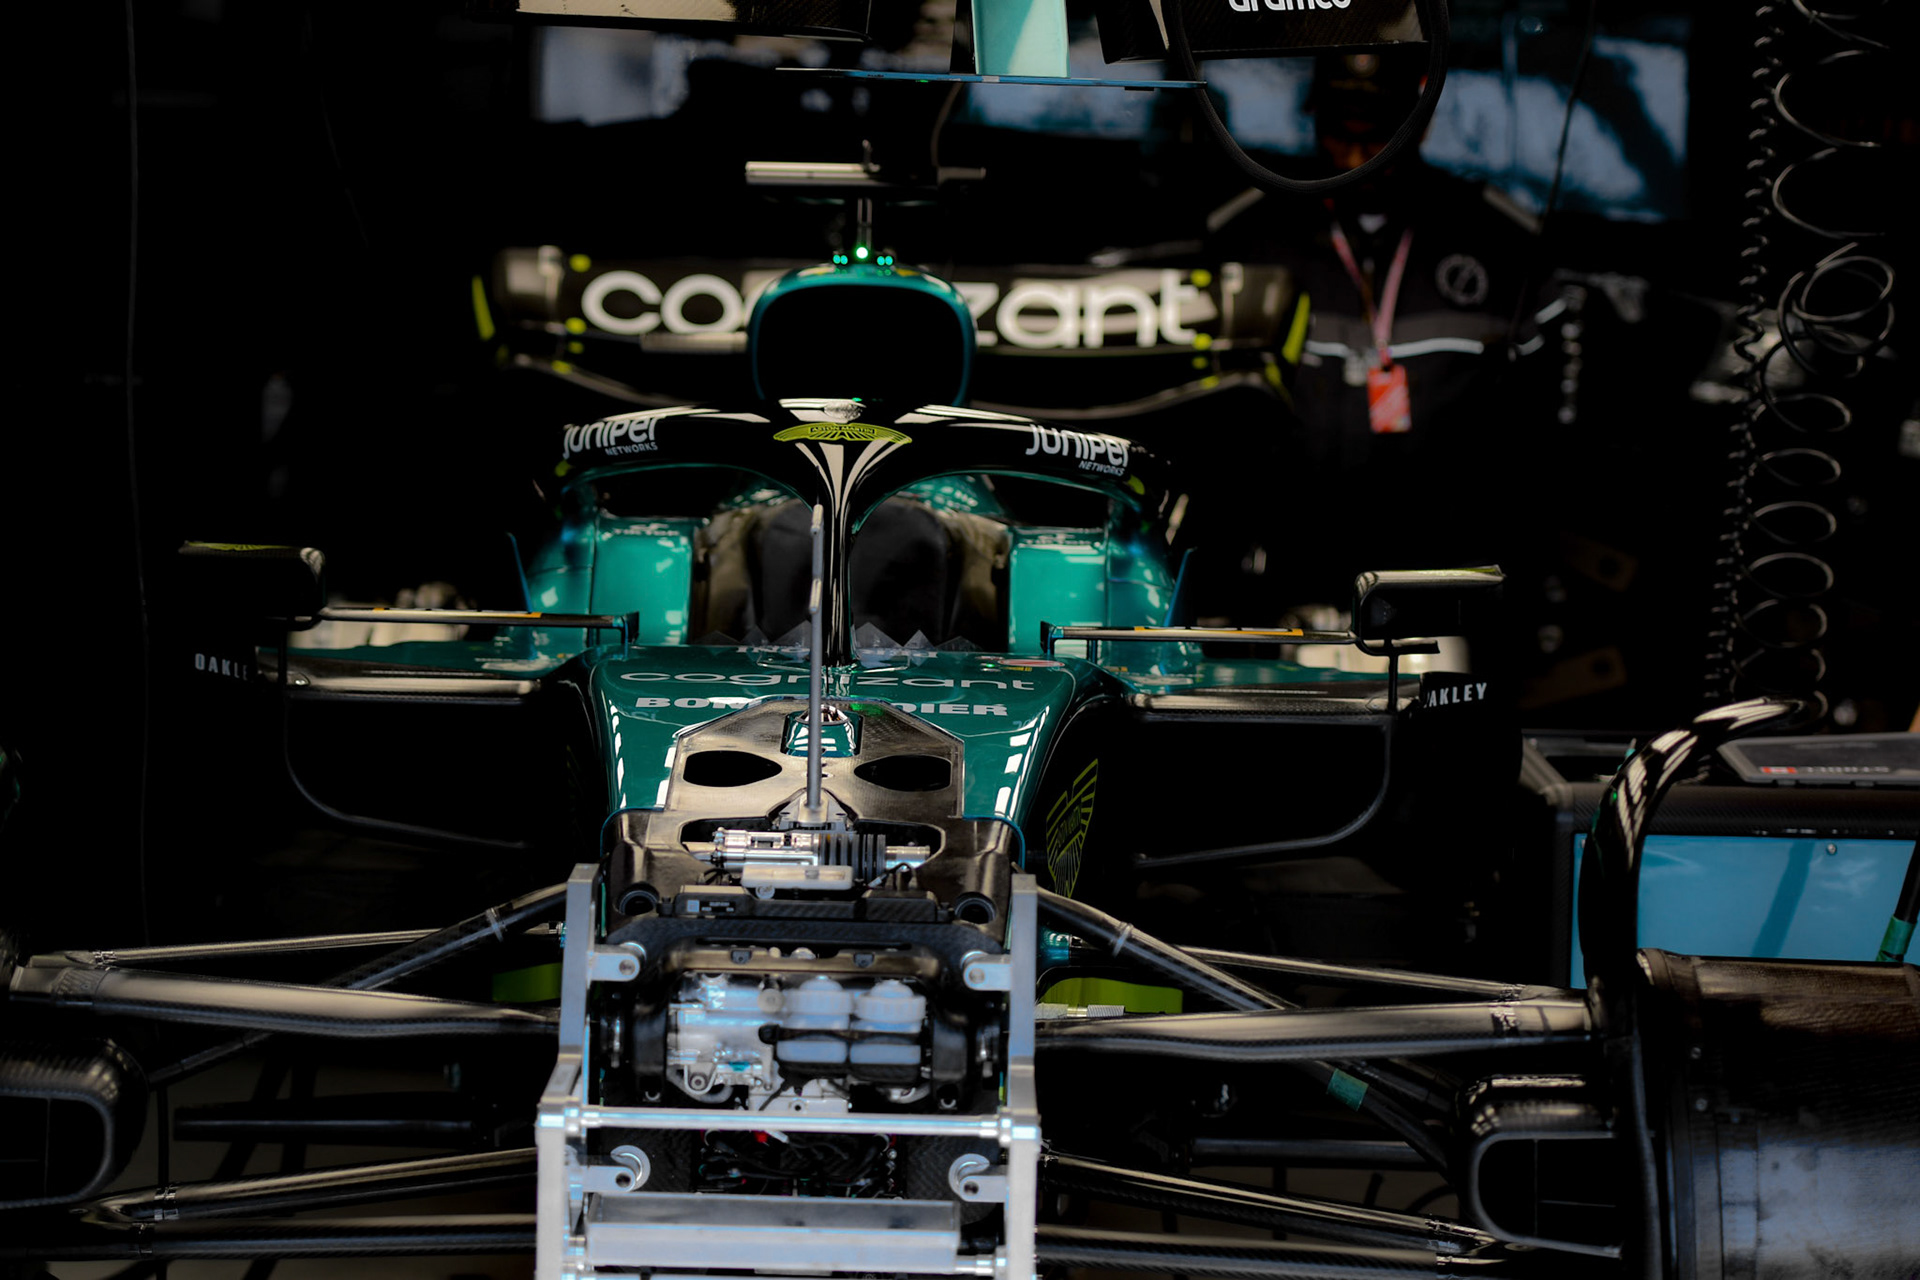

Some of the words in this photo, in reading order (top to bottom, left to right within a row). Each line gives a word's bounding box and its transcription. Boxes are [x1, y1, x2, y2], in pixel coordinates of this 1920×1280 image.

[581, 269, 1200, 350] cozant
[605, 442, 658, 456] NETWORKS
[1078, 460, 1125, 476] NETWORKS
[195, 653, 248, 681] OAKLE
[1423, 682, 1487, 708] AKLEY
[634, 697, 1008, 716] BOMDIER
